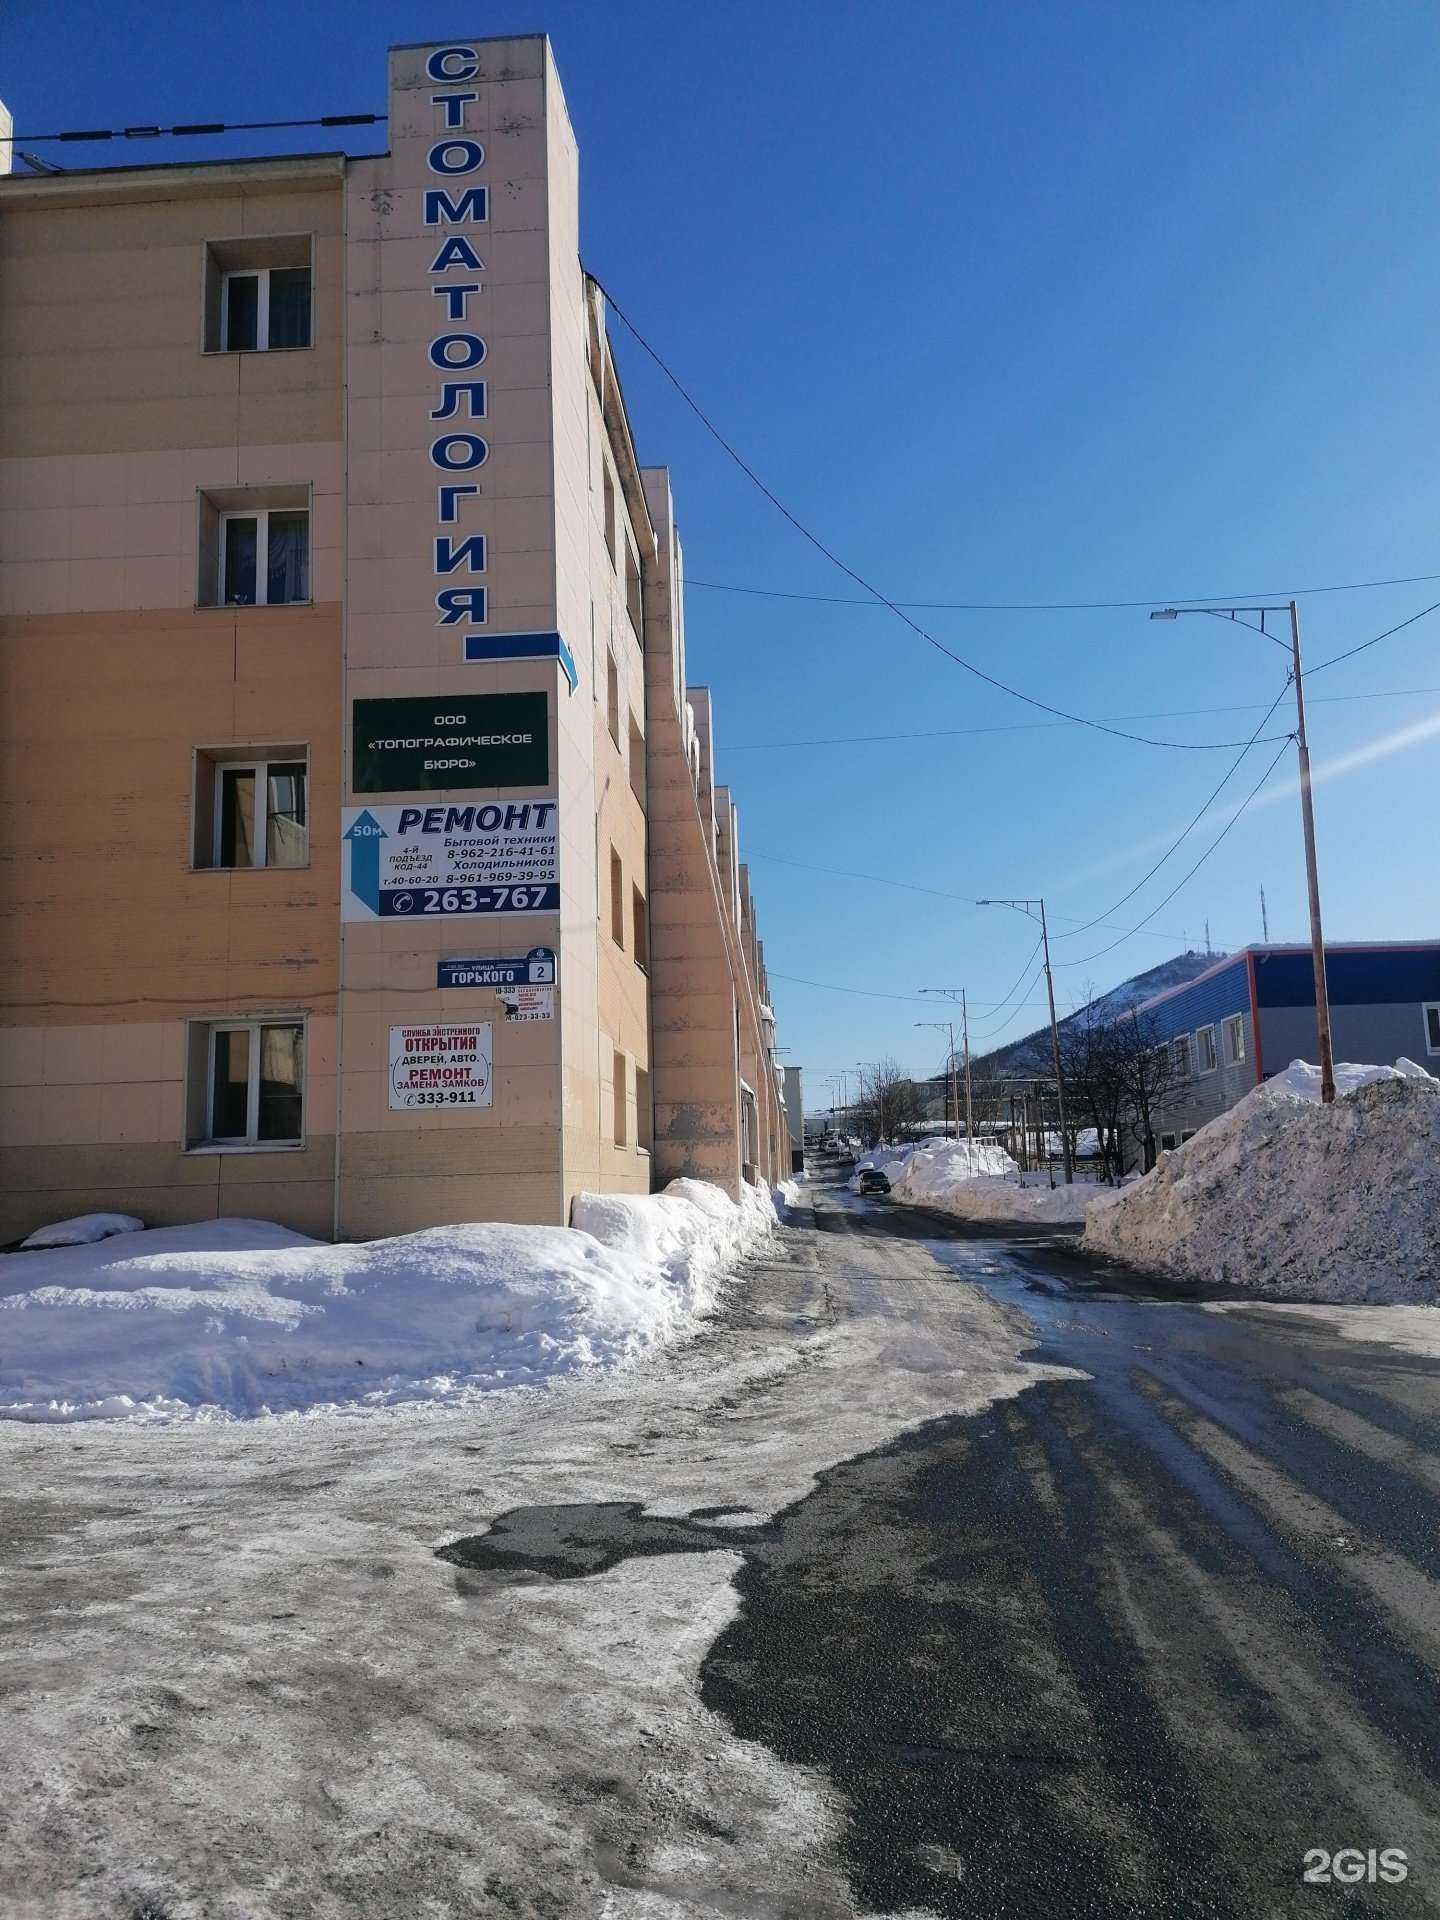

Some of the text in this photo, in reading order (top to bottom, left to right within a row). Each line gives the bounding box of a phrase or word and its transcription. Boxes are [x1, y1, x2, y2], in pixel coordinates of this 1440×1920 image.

[423, 47, 490, 627] СТОМАТОЛОГИЯ
[434, 715, 467, 726] ООО
[368, 733, 533, 751] «ТОПОГРАФИЧЕСКОЕ
[424, 758, 476, 770] БЮРО»
[397, 803, 557, 835] РЕМОНТ
[444, 835, 556, 848] Бытовой техники
[389, 854, 433, 863] ПОДЪЕЗД
[447, 846, 556, 859] 8-962-216-41-61
[394, 862, 428, 871] КОД-44
[452, 857, 555, 871] Холодильников
[446, 870, 555, 884] 8-961-969-39-95
[423, 886, 548, 912] 263-767
[451, 970, 514, 983] ГОРЬКОГО
[537, 966, 545, 978] 2
[402, 1027, 480, 1038] СЛУЖБА ЭКСТРЕННОГО
[405, 1036, 477, 1052] ОТКРЫТИЯ
[409, 1068, 472, 1081] РЕМОНТ
[397, 1079, 484, 1090] ЗАМЕНА ЗАМКОВ
[417, 1091, 476, 1104] 333-911
